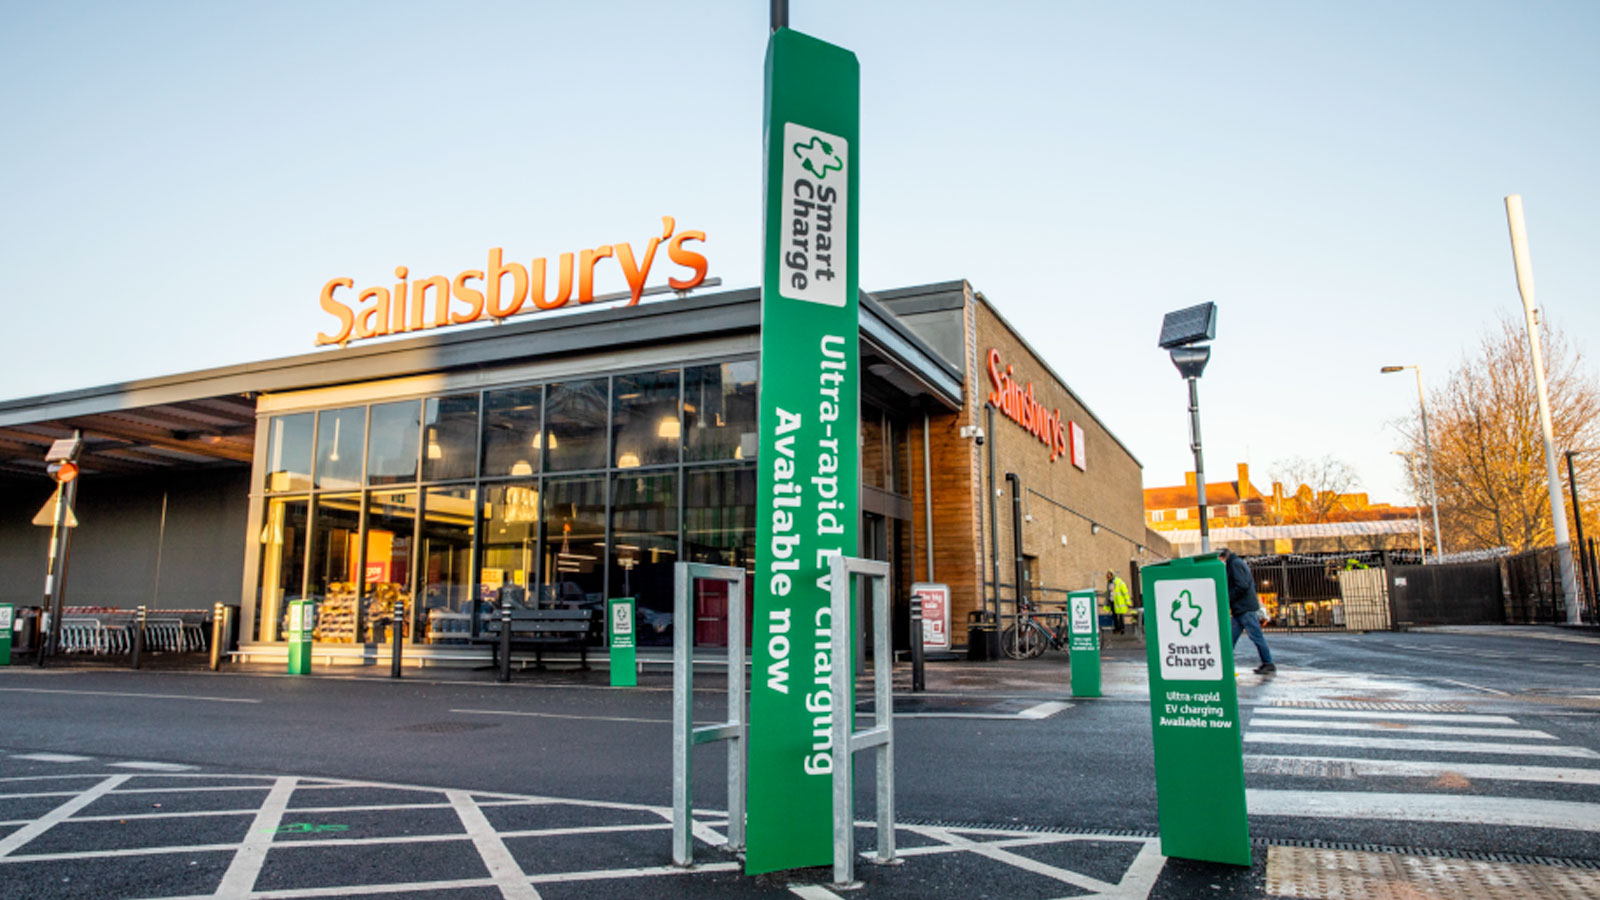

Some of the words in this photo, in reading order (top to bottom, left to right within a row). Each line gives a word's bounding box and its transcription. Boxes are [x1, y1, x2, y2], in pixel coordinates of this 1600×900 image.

[785, 178, 815, 290] Charge
[815, 184, 837, 281] Smart
[316, 215, 708, 344] Sainsbury's
[811, 334, 847, 535] Ultra-rapid
[986, 348, 1065, 462] Sainsbury's
[770, 406, 802, 596] Available
[767, 608, 791, 694] now
[1165, 655, 1216, 670] Charge
[1167, 643, 1211, 655] Smart
[1159, 716, 1208, 728] Available
[1209, 720, 1232, 729] now
[1164, 703, 1178, 714] EV
[1179, 704, 1224, 717] charging
[1165, 691, 1221, 703] Ultra-rapid
